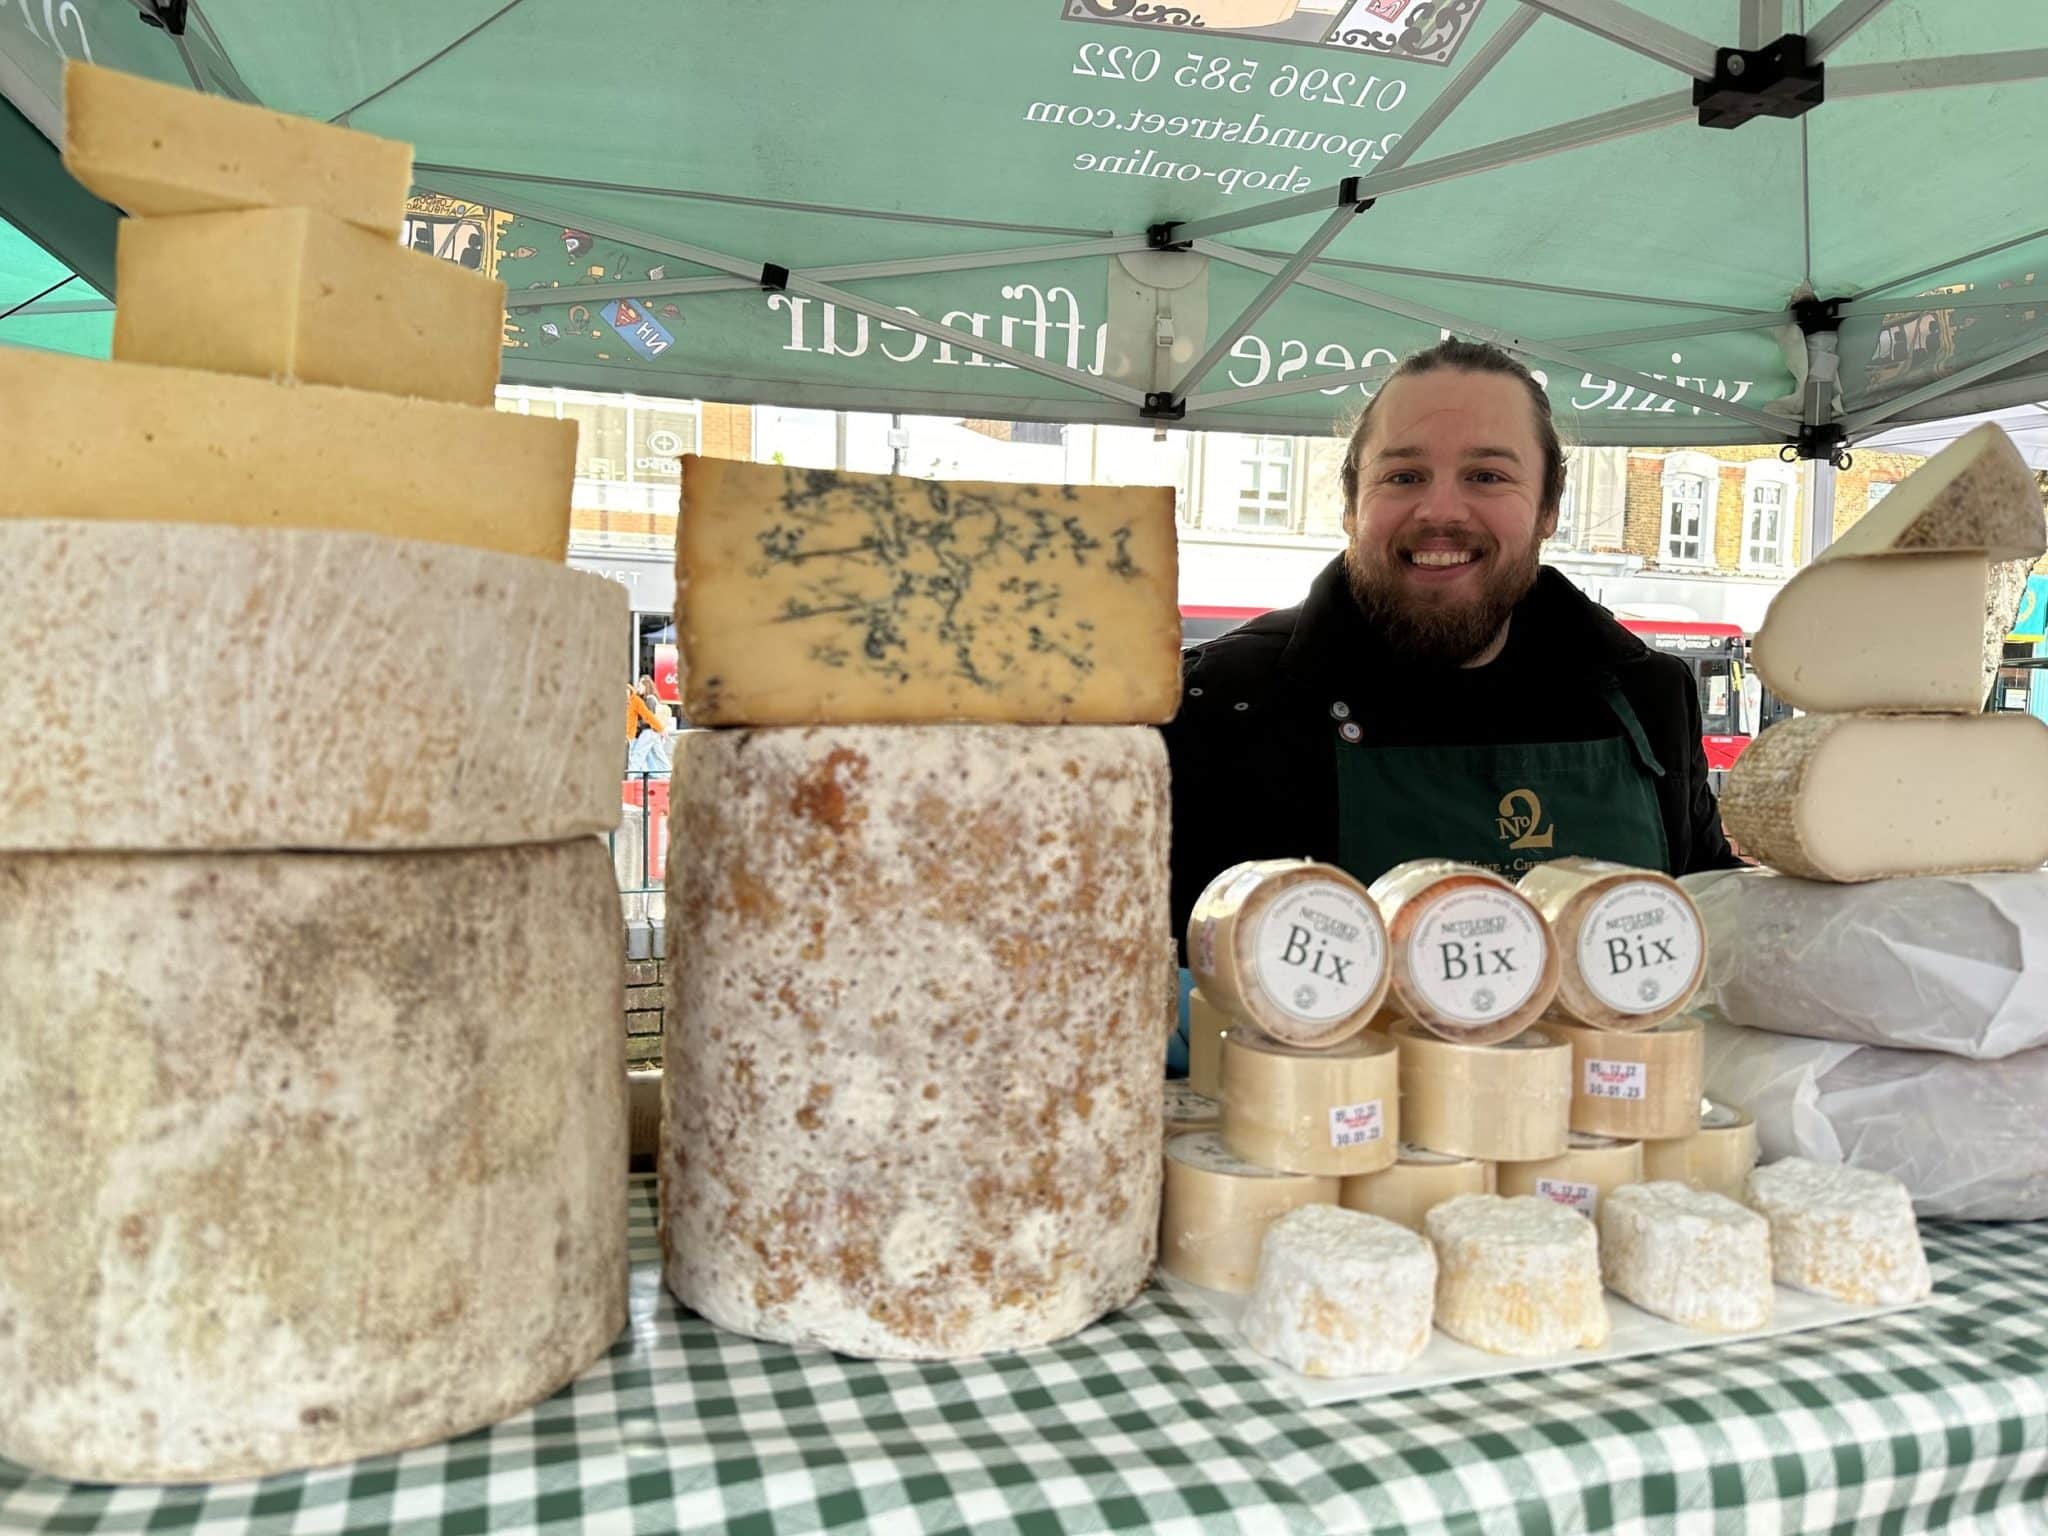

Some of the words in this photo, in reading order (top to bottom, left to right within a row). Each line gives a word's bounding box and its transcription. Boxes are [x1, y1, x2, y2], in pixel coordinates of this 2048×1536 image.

[1280, 923, 1353, 985] Bix
[1438, 941, 1518, 981] Bix
[1603, 935, 1677, 976] Bix
